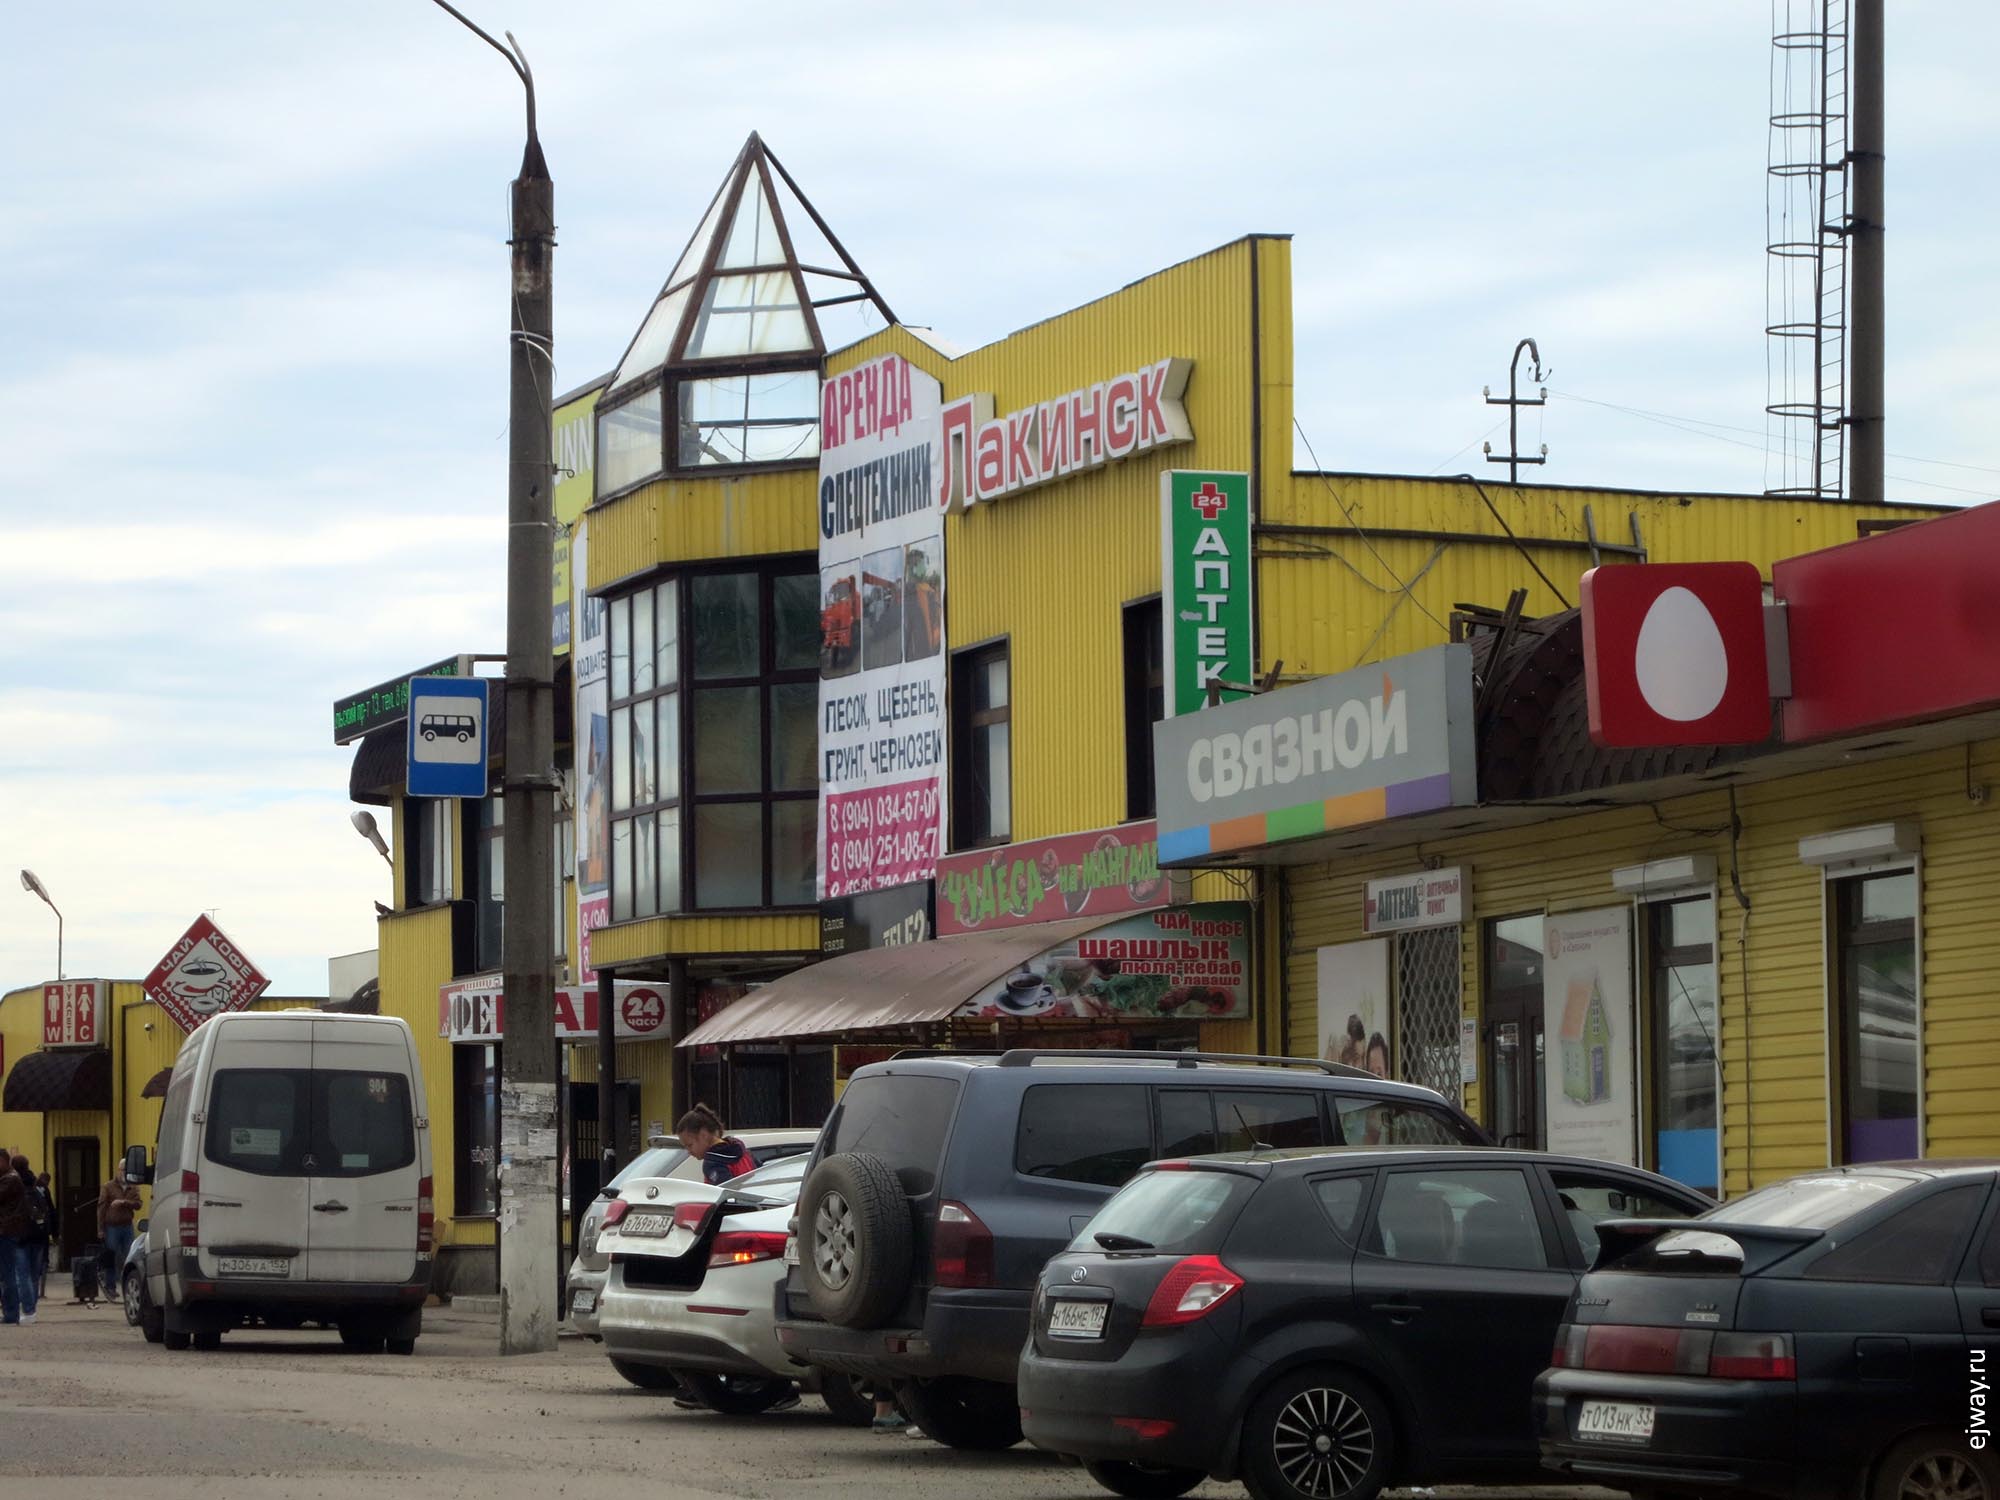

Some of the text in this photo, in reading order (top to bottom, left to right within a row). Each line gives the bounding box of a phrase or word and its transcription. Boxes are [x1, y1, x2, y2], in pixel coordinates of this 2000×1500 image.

[824, 357, 912, 449] АРЕНДА
[821, 442, 932, 539] СПЕЦТЕХНИКИ
[1198, 496, 1222, 507] 24
[826, 680, 939, 733] ПЕСОК, ЩЕБЕНЬ,
[1187, 672, 1408, 803] СВЯЗНОЙ
[826, 744, 867, 783] ГРУНТ,
[830, 803, 838, 833] 8
[841, 797, 873, 839] (904)
[831, 842, 839, 873] 8
[843, 837, 873, 878] (904)
[948, 858, 1044, 923] ЧУДЕСА
[1376, 886, 1420, 922] АПТЕКА
[1153, 911, 1242, 937] ЧАЙ КОФЕ
[160, 937, 195, 972] ЧАЙ
[207, 931, 253, 979] КОФЕ
[1078, 939, 1230, 960] шашлык
[1120, 960, 1242, 976] люля-кебаб
[1171, 974, 1241, 986] в лаваше
[151, 985, 196, 1033] ГОРЯЧА
[228, 980, 260, 1012] ЕЧКА
[627, 997, 661, 1017] 24
[46, 1025, 90, 1042] W C
[627, 1017, 659, 1027] часа
[1636, 1406, 1652, 1426] 33
